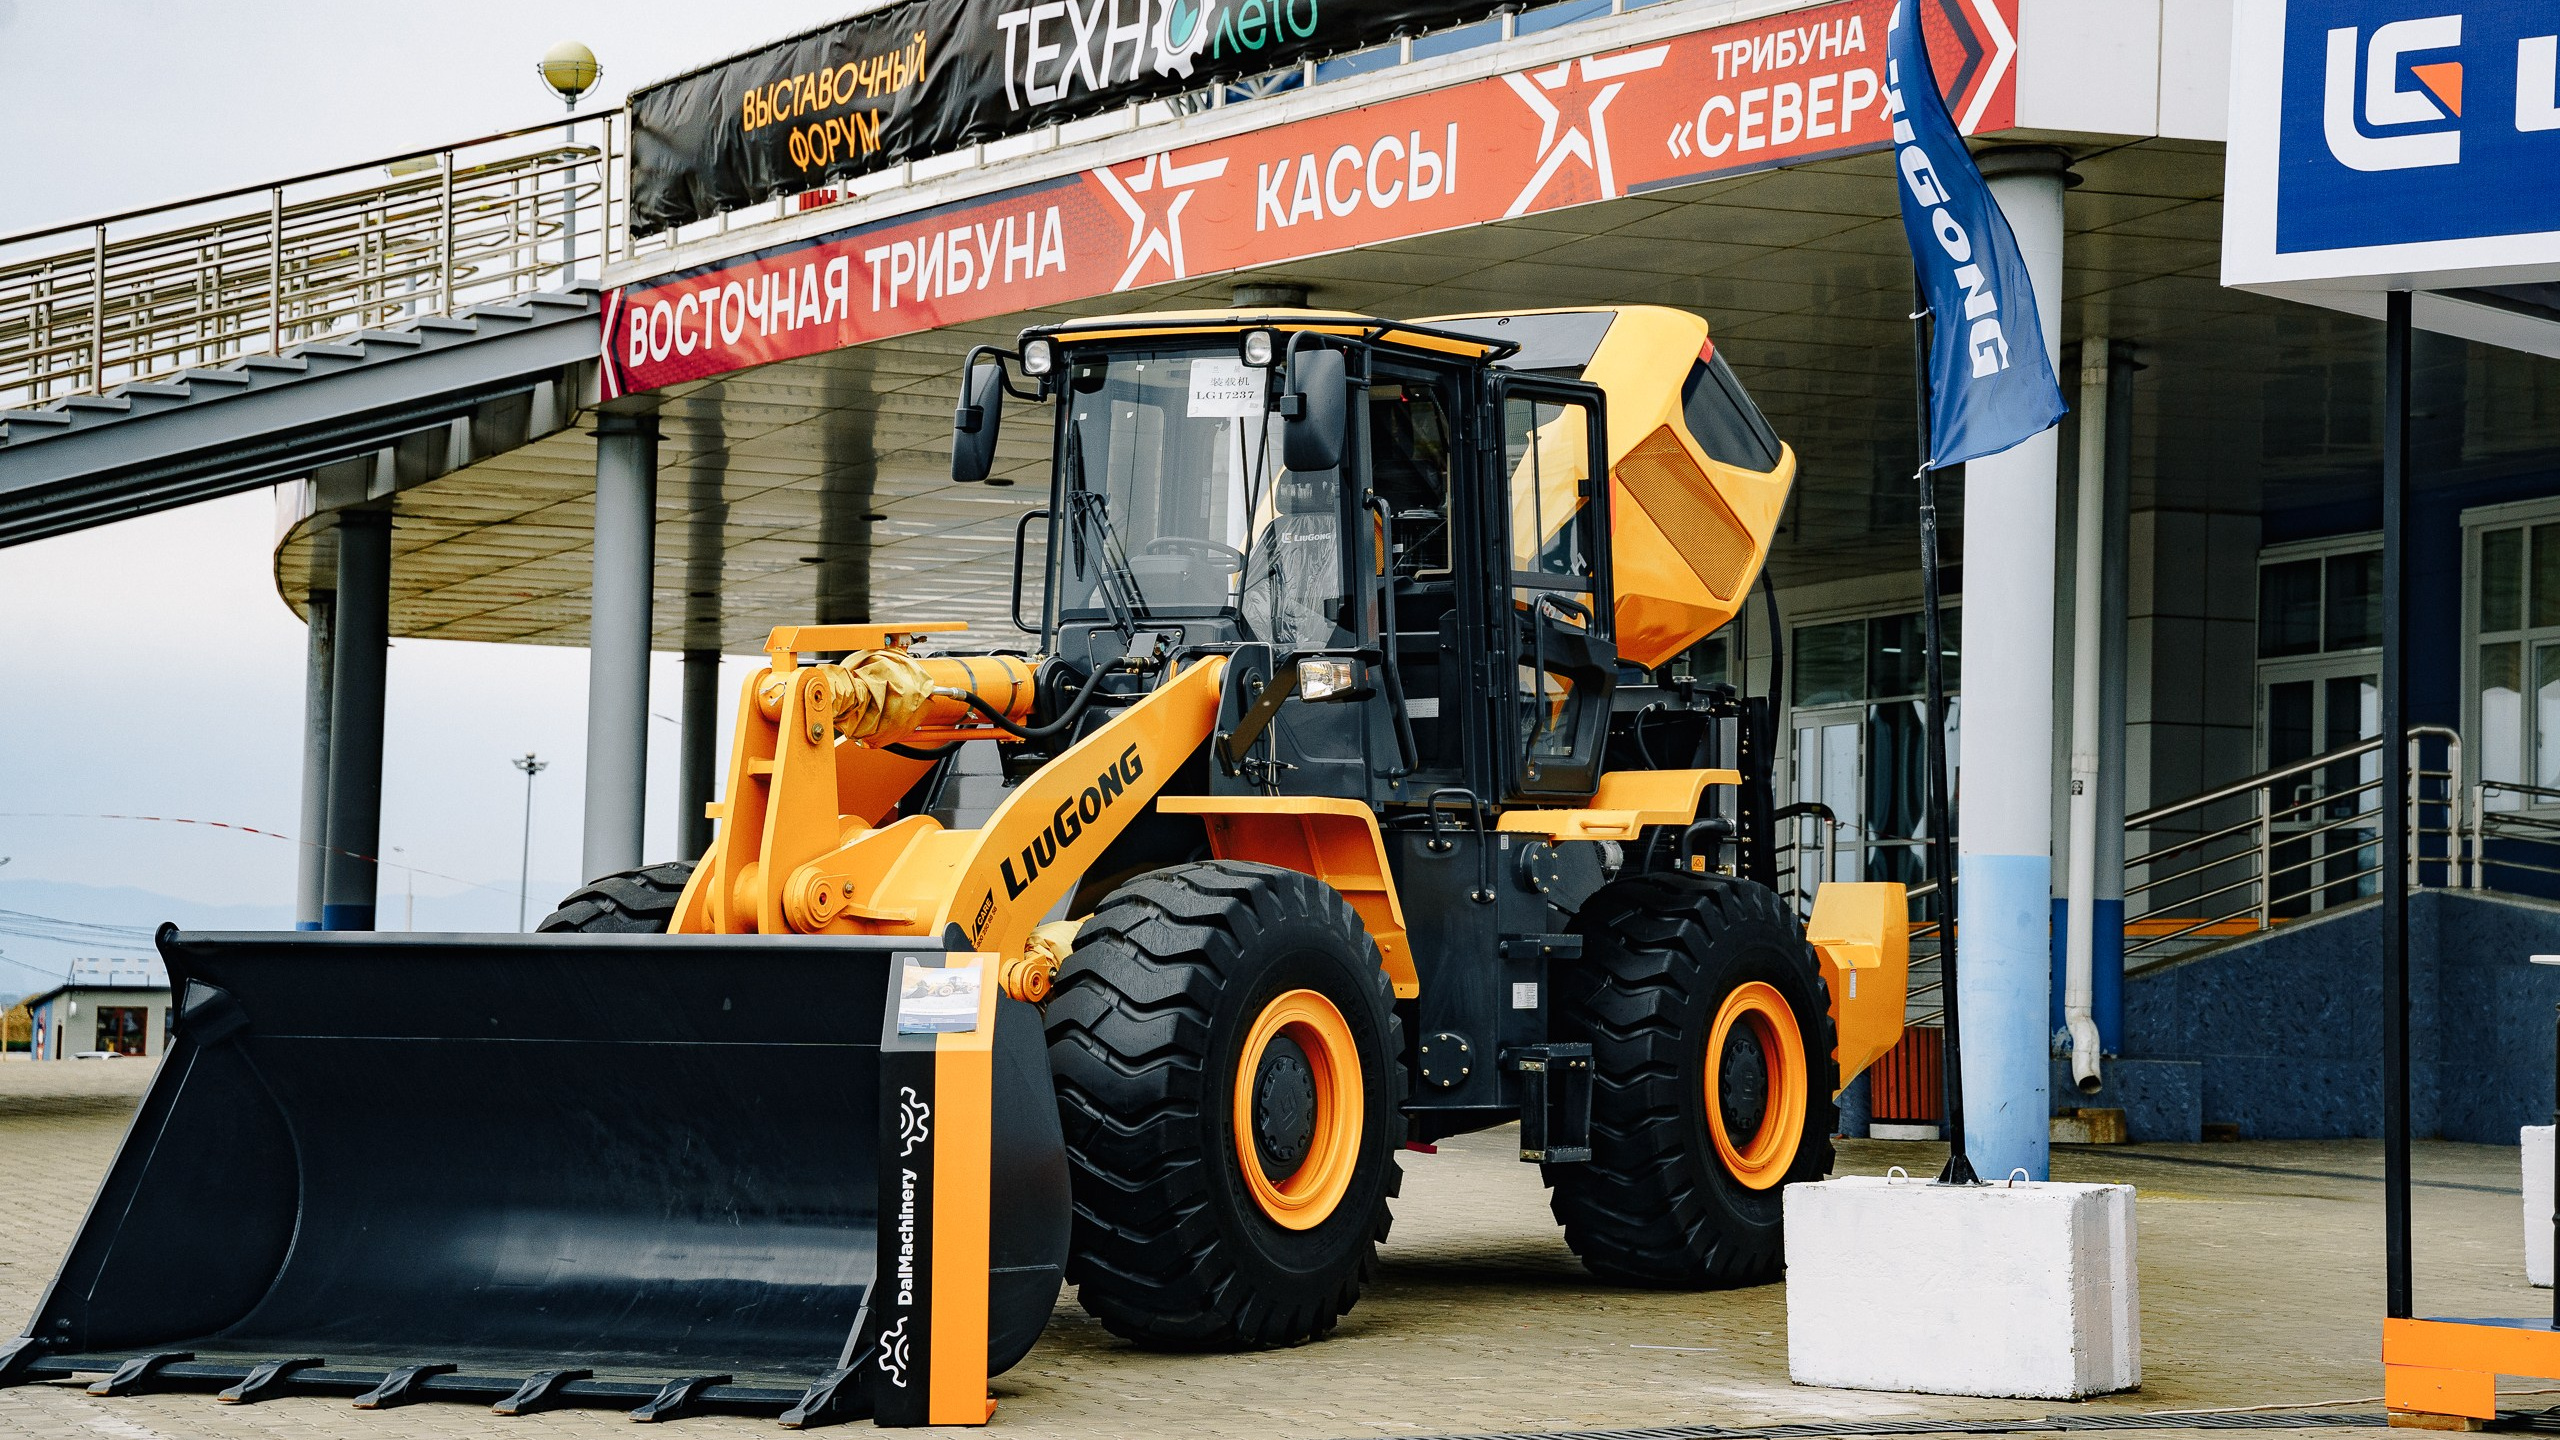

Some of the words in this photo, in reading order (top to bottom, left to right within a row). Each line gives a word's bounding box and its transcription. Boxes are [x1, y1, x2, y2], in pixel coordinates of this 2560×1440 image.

[742, 29, 928, 132] ВЫСТАВОЧНЫЙ
[1711, 15, 1866, 81] ТРИБУНА
[788, 108, 881, 172] ФОРУМ
[1256, 122, 1458, 232] КАССЫ
[629, 255, 849, 368] ВОСТОЧНАЯ
[864, 205, 1067, 312] ТРИБУНА
[1196, 391, 1255, 400] LG17237
[977, 898, 993, 926] CARE
[897, 1168, 918, 1306] DalMachinery
